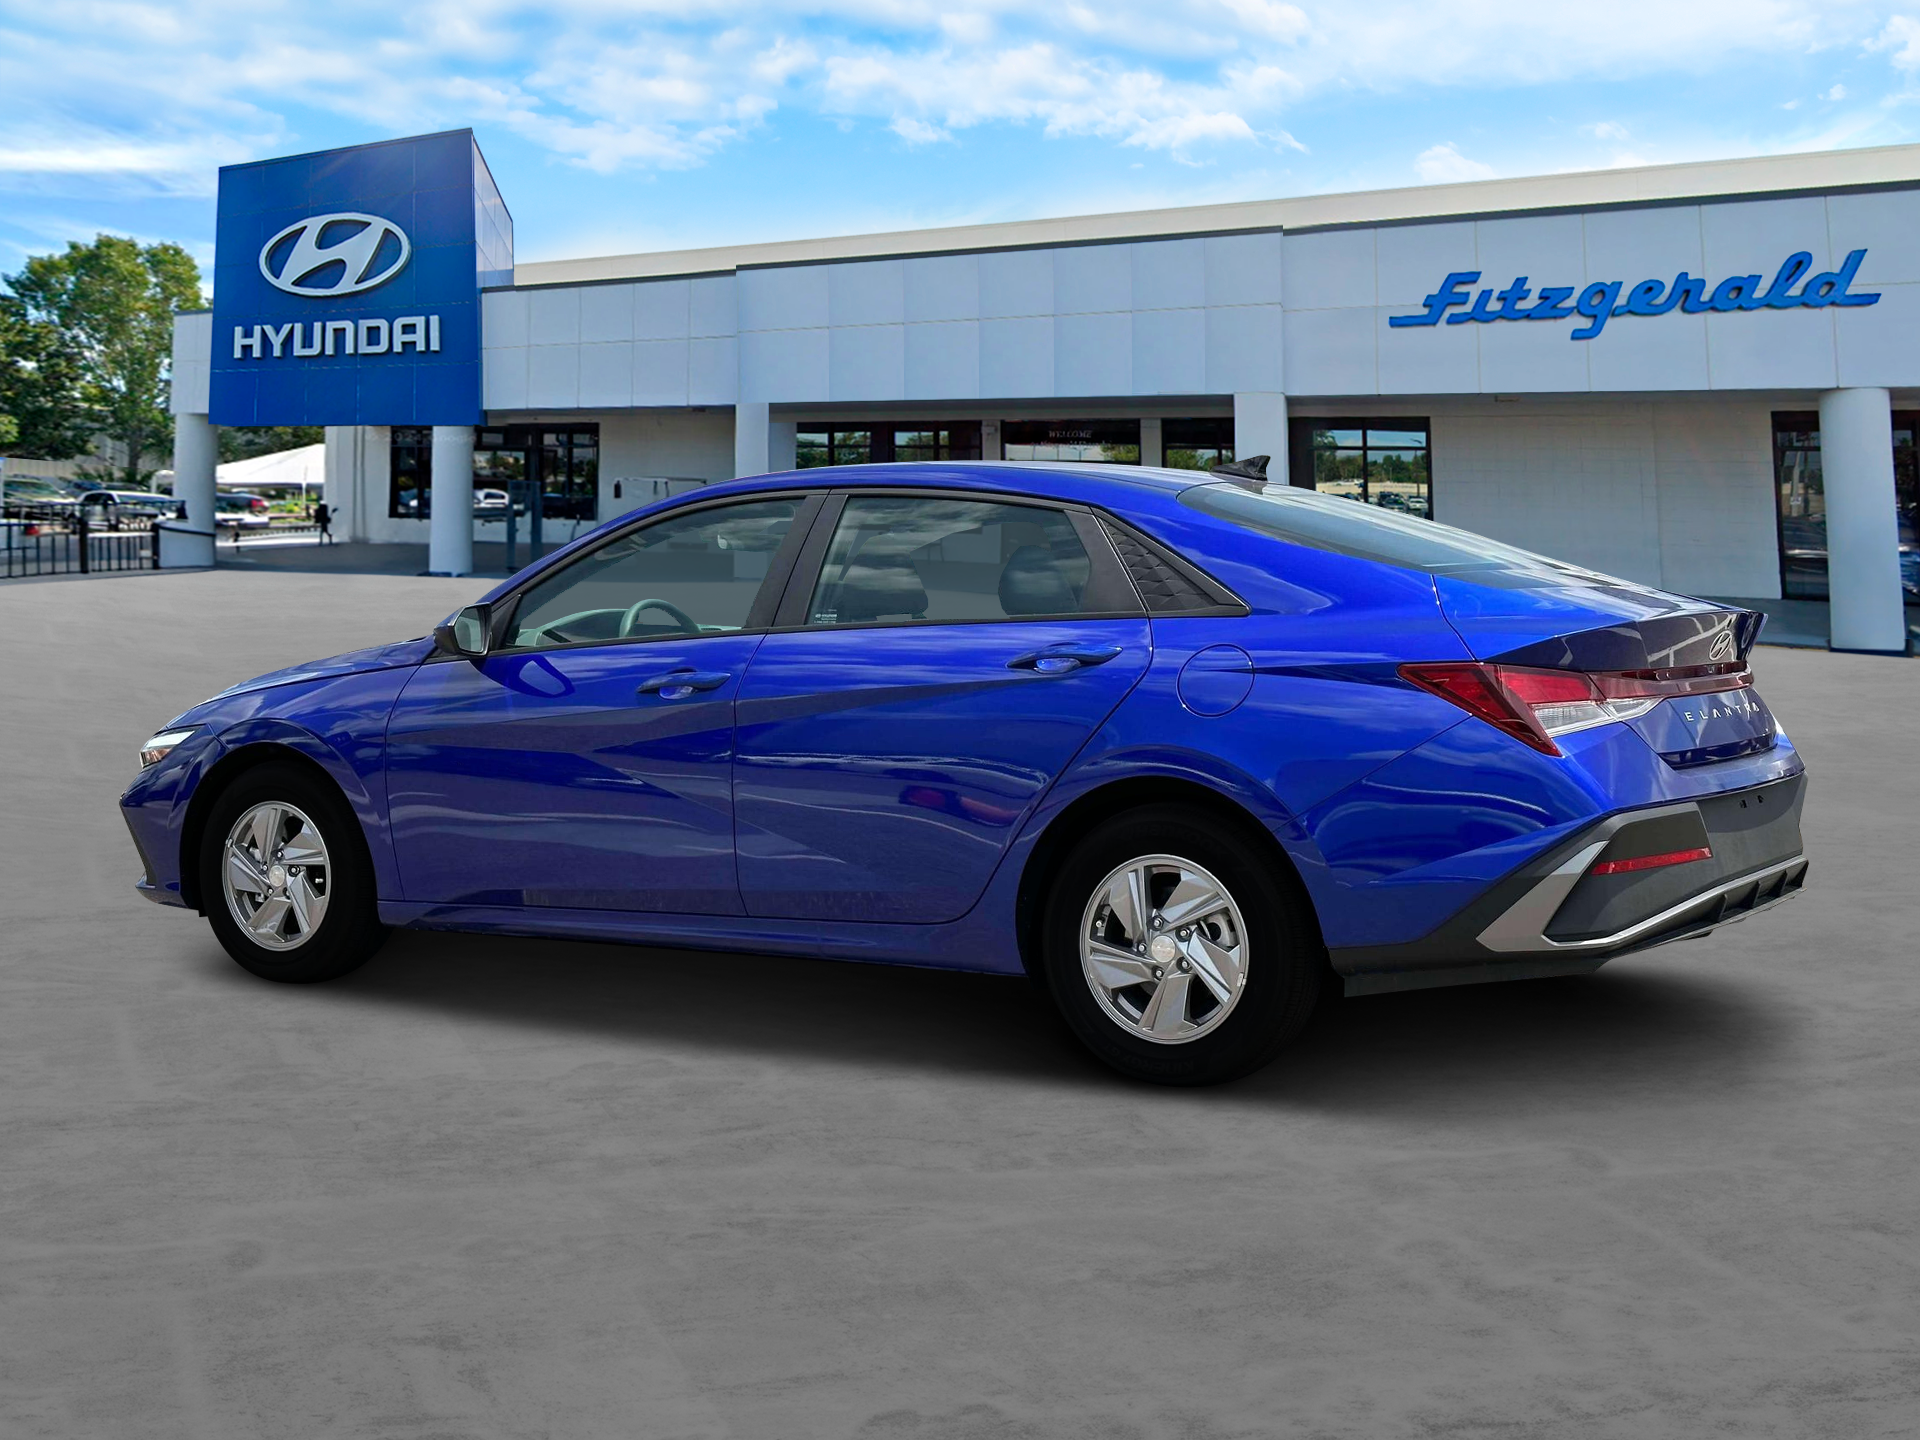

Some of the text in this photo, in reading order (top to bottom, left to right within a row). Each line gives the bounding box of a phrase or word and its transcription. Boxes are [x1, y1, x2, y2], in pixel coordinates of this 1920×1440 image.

[1389, 248, 1881, 340] Fitzgerald
[233, 315, 440, 359] HYUNDAI
[1048, 430, 1093, 439] WELCOME
[1684, 702, 1760, 721] ELANTRA
